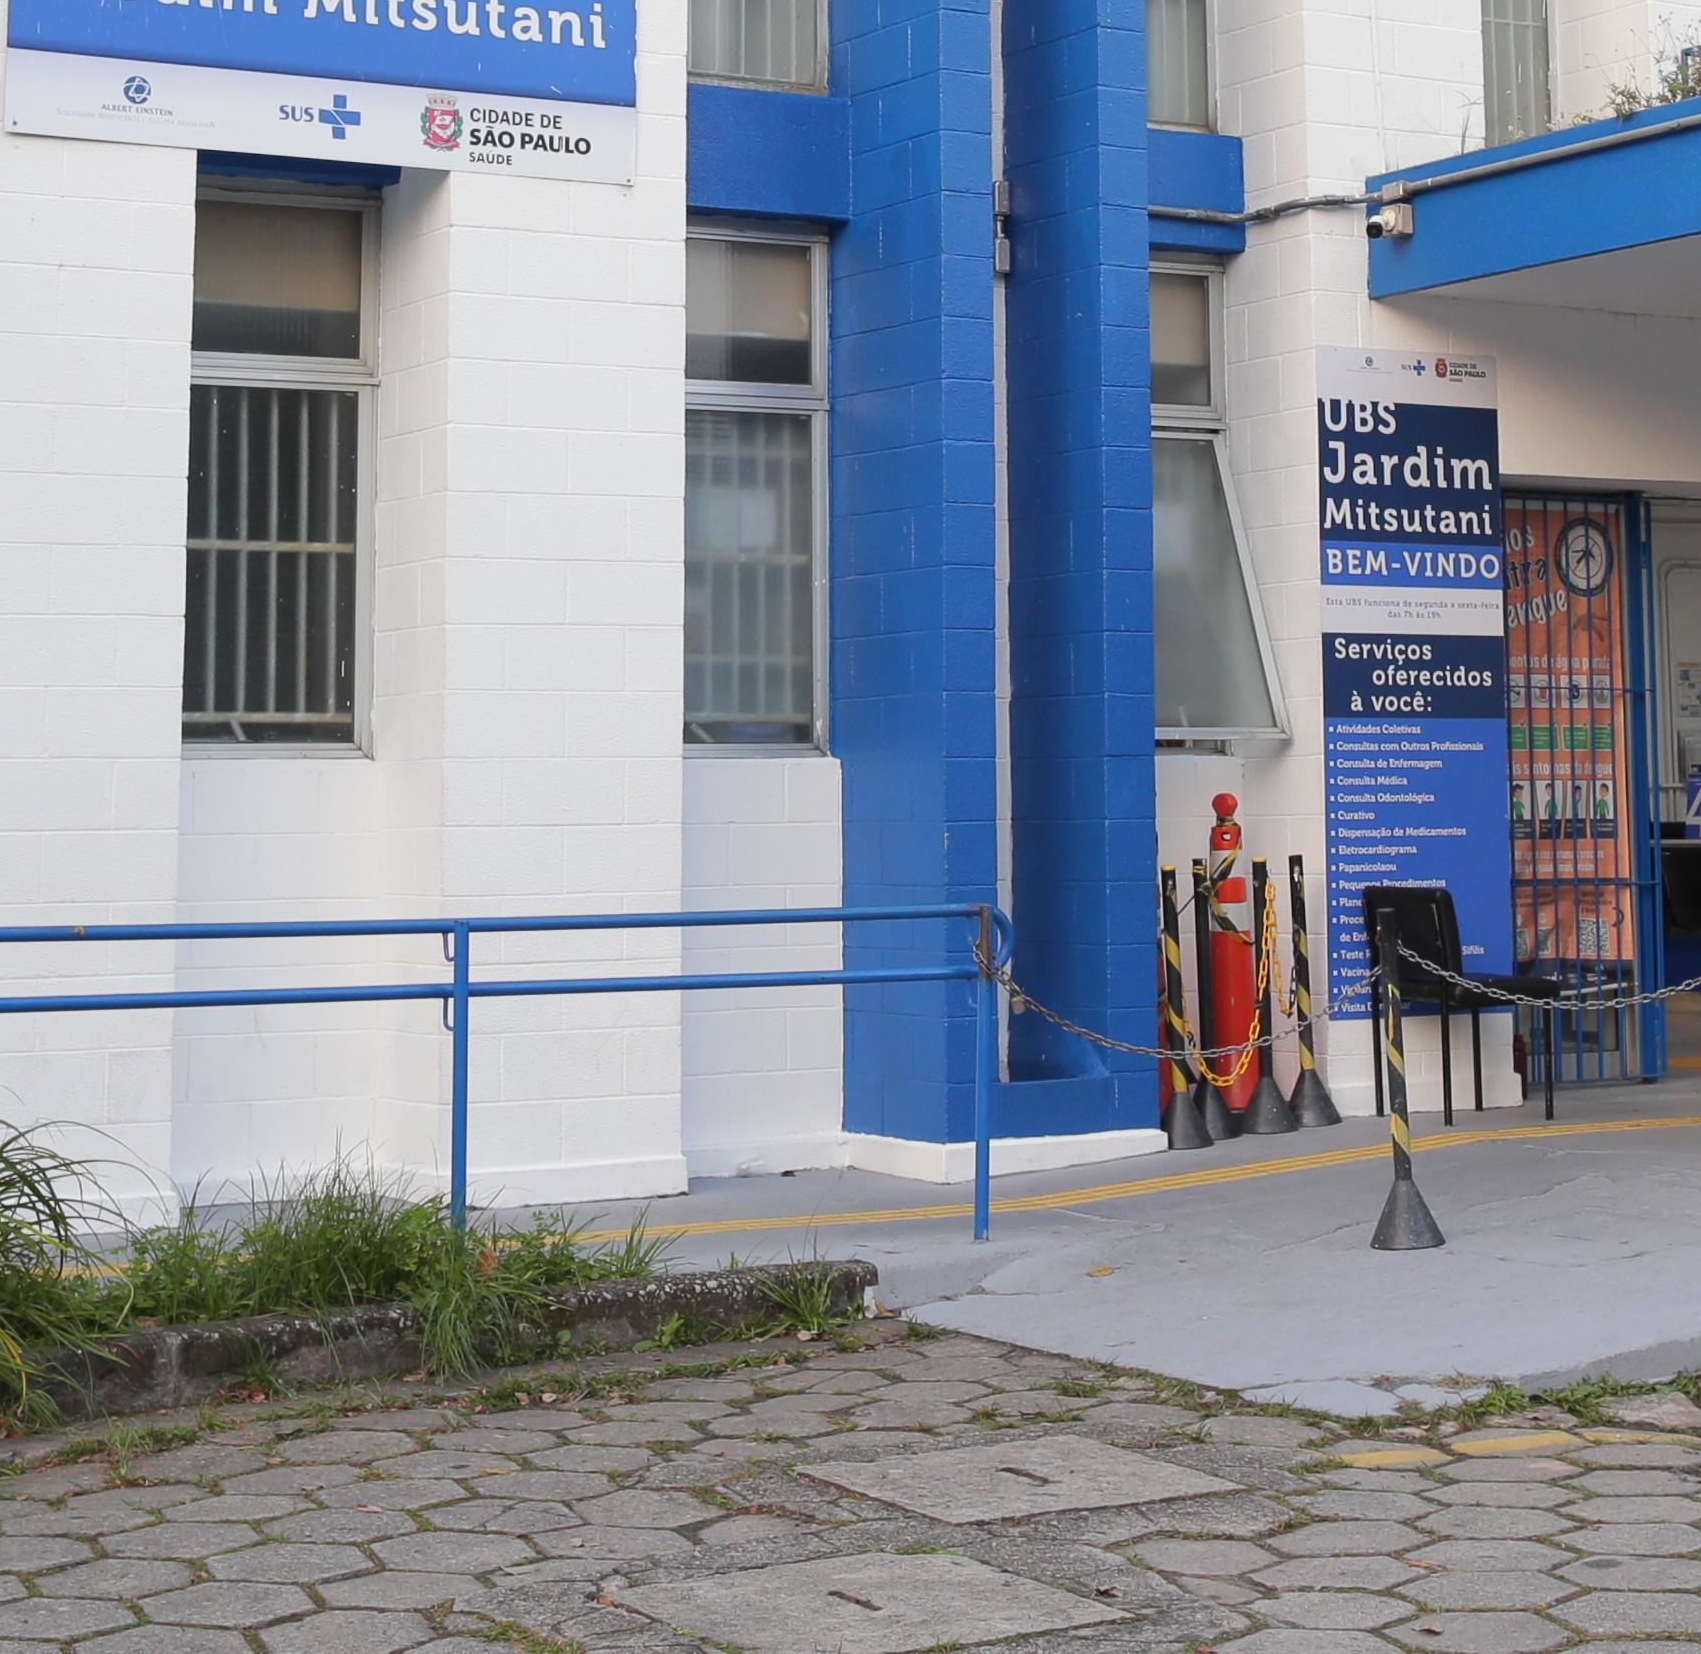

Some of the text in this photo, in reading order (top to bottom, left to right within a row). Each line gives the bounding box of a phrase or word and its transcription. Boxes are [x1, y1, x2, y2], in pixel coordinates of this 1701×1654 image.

[101, 103, 174, 116] ALBERT EINSTEIN
[279, 105, 315, 122] SUS
[470, 108, 562, 129] CIDADE DE
[469, 126, 591, 155] SÃO PAULO
[469, 150, 513, 165] SAÚDE
[1322, 398, 1397, 435] UBS
[1323, 441, 1492, 490] Jardim
[1323, 498, 1493, 535] Mitsutani
[1326, 548, 1500, 579] BEM-VINDO
[1326, 598, 1343, 606] Esta
[1346, 598, 1361, 606] UBS
[1364, 599, 1400, 607] funciona
[1415, 600, 1448, 609] segunda
[1457, 601, 1500, 609] sexta-feira
[1334, 637, 1432, 665] Serviços
[1372, 664, 1492, 686] oferecidos
[1350, 690, 1432, 712] à você:
[1336, 724, 1421, 734] Atividades Coletivas
[1337, 741, 1484, 751] Consultas com Outros Profissionais
[1337, 759, 1442, 770] Consulta de Enfermagem
[1337, 775, 1408, 785] Consulta Médica
[1337, 793, 1435, 804] Consulta Odontológica
[1338, 811, 1375, 820] Curativo
[1338, 827, 1466, 839] Dispensação de Medicamentos
[1338, 845, 1417, 856] Eletrocardiograma
[1339, 862, 1397, 874] Papanicolaou
[1383, 879, 1446, 888] Procedimentos
[1339, 932, 1351, 942] de
[1340, 950, 1364, 959] Teste
[1341, 1002, 1366, 1012] Visita
